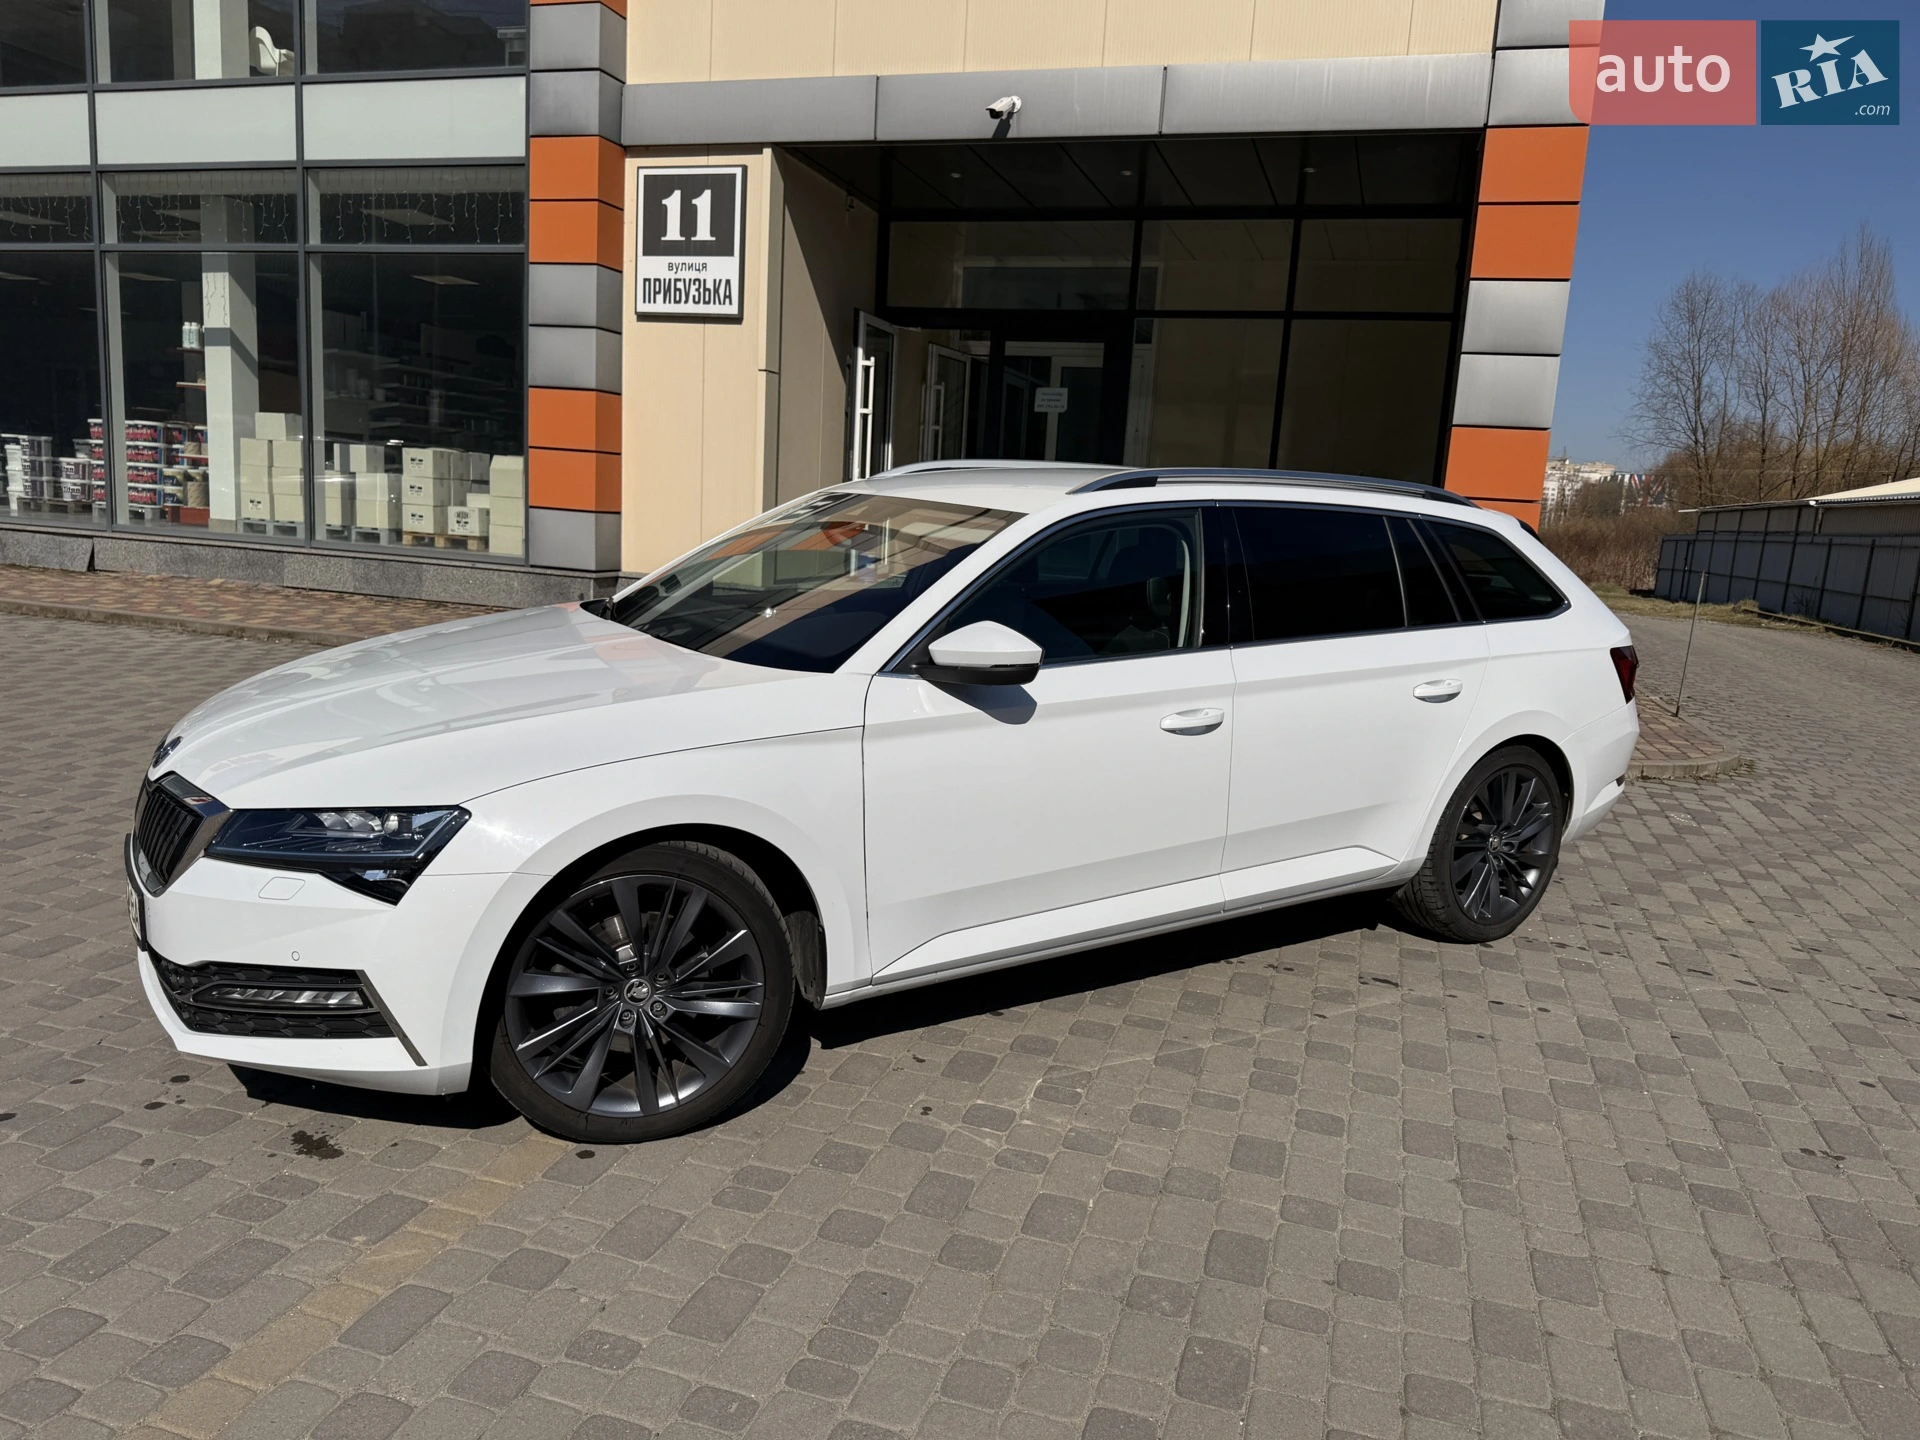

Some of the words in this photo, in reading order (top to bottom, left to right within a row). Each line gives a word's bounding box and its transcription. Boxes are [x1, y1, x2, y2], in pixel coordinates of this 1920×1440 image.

[660, 189, 717, 241] 11
[667, 261, 708, 275] вулиця
[642, 277, 733, 306] ПРИБУЗЬКА
